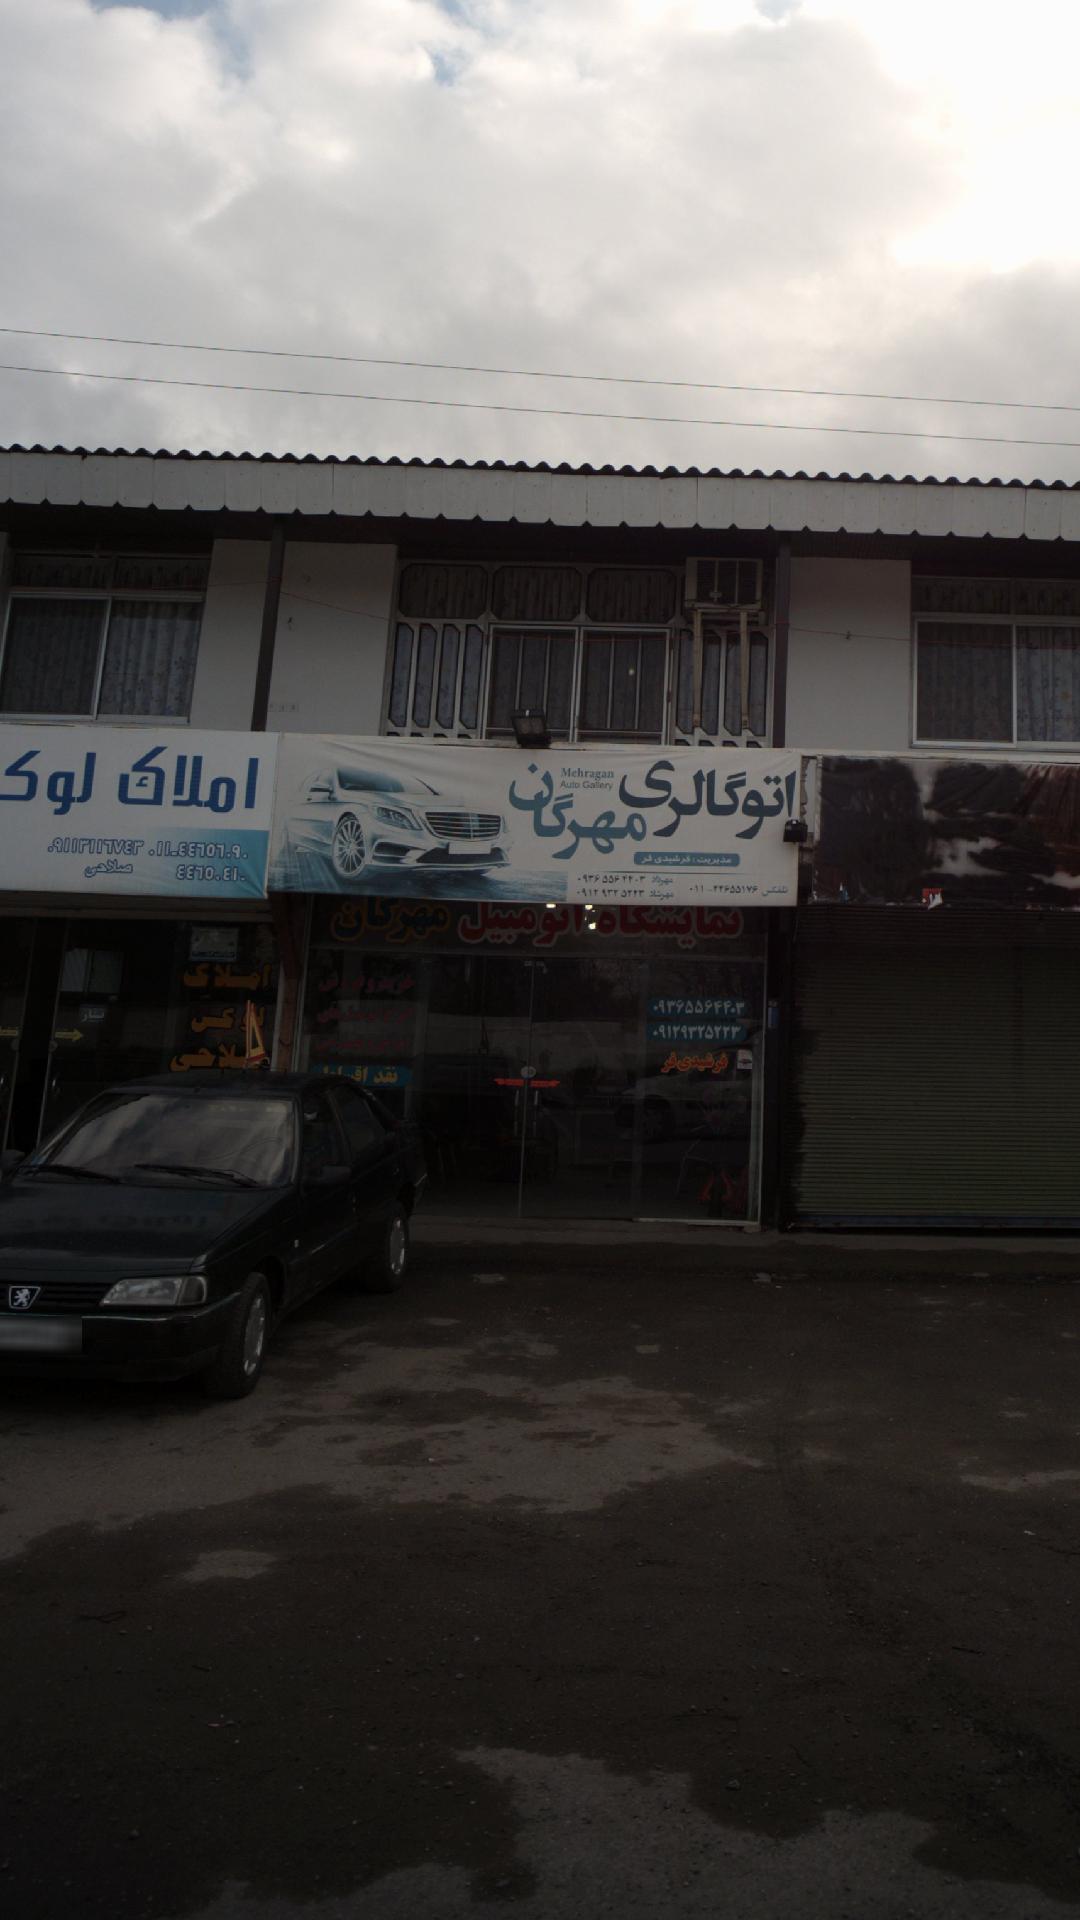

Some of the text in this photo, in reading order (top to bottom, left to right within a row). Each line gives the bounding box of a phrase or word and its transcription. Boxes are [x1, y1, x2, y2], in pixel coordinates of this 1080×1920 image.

[0, 746, 259, 815] املاک لوک
[560, 768, 614, 781] Mehragan
[560, 780, 613, 790] Auto Gallery
[618, 760, 797, 839] اتوگالری
[508, 763, 647, 860] مهرگان
